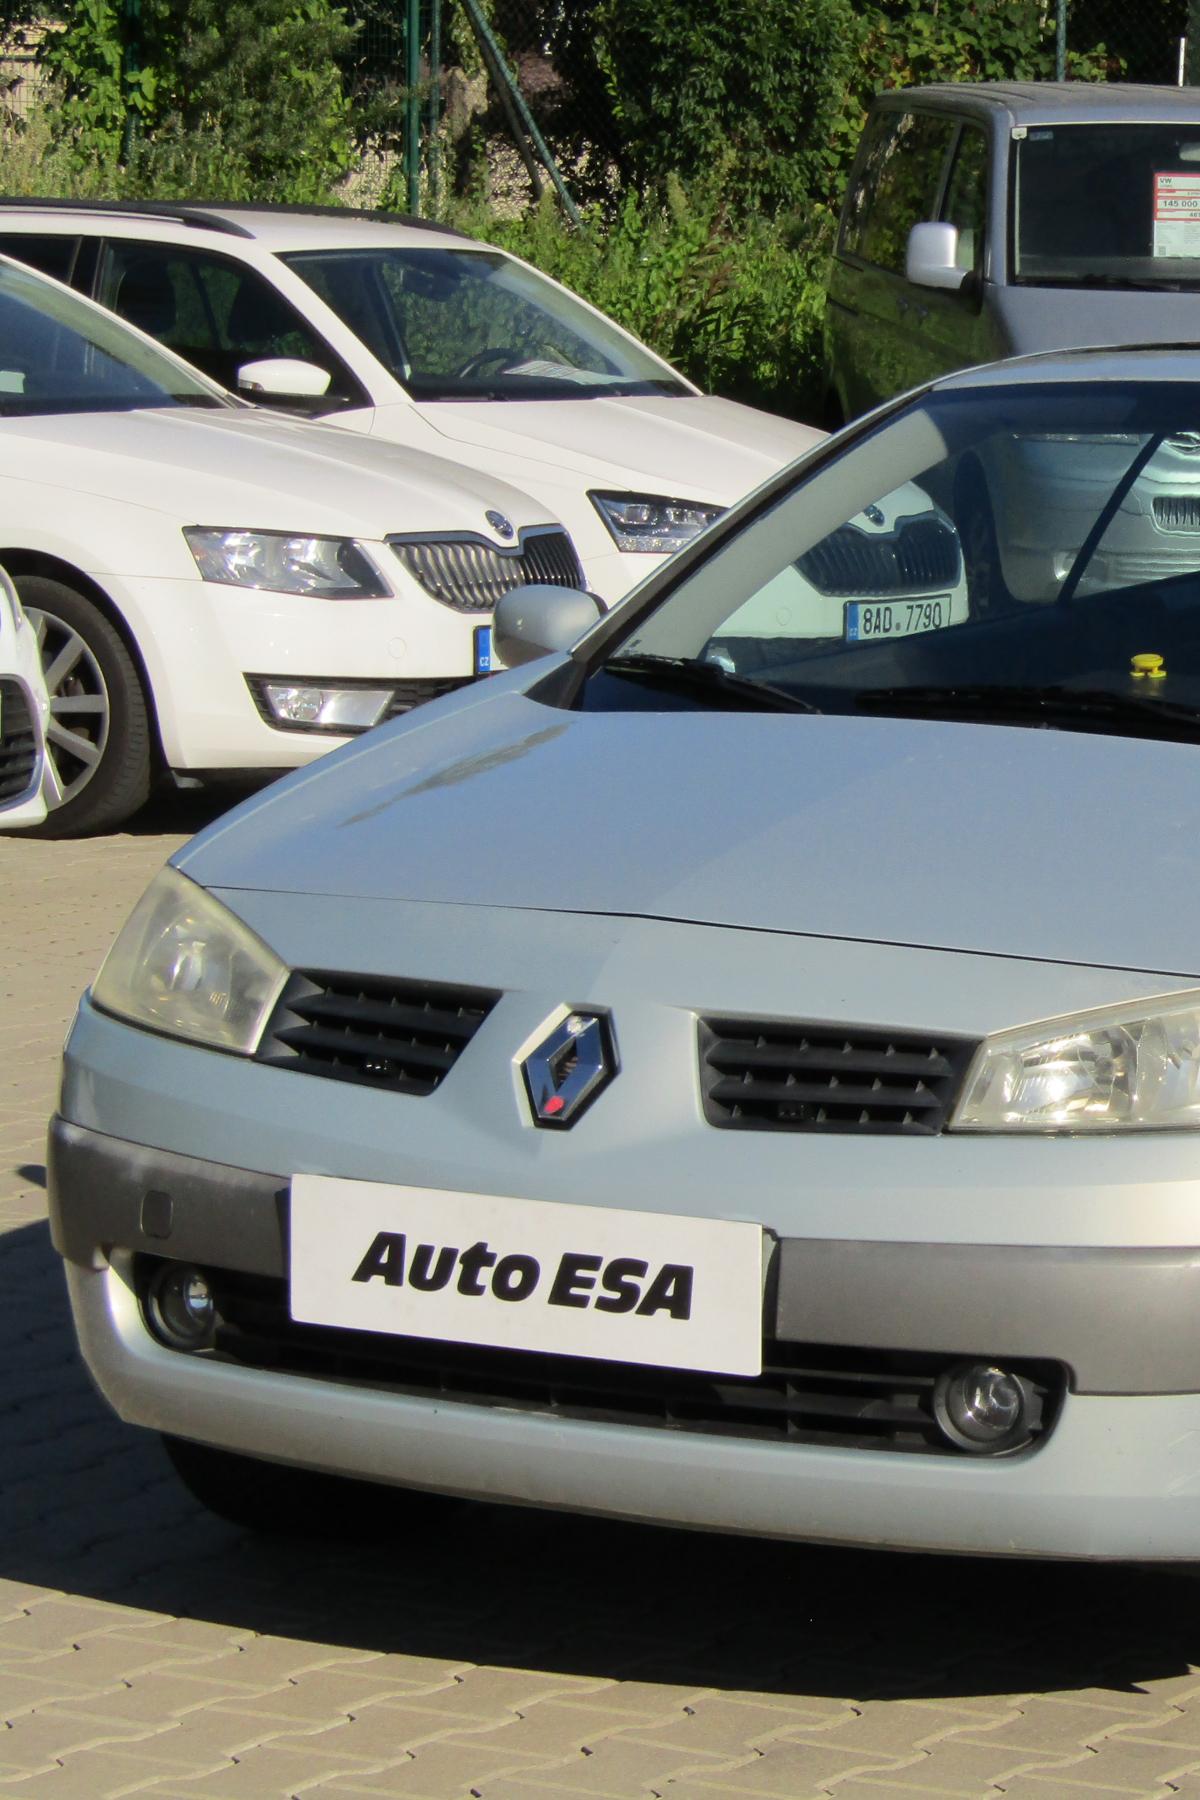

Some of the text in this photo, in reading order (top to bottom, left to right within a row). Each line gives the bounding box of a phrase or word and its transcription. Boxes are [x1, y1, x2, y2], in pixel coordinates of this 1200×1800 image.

[863, 602, 942, 634] 8AD 7790
[479, 656, 489, 667] CZ
[351, 1231, 695, 1321] Auto ESA
